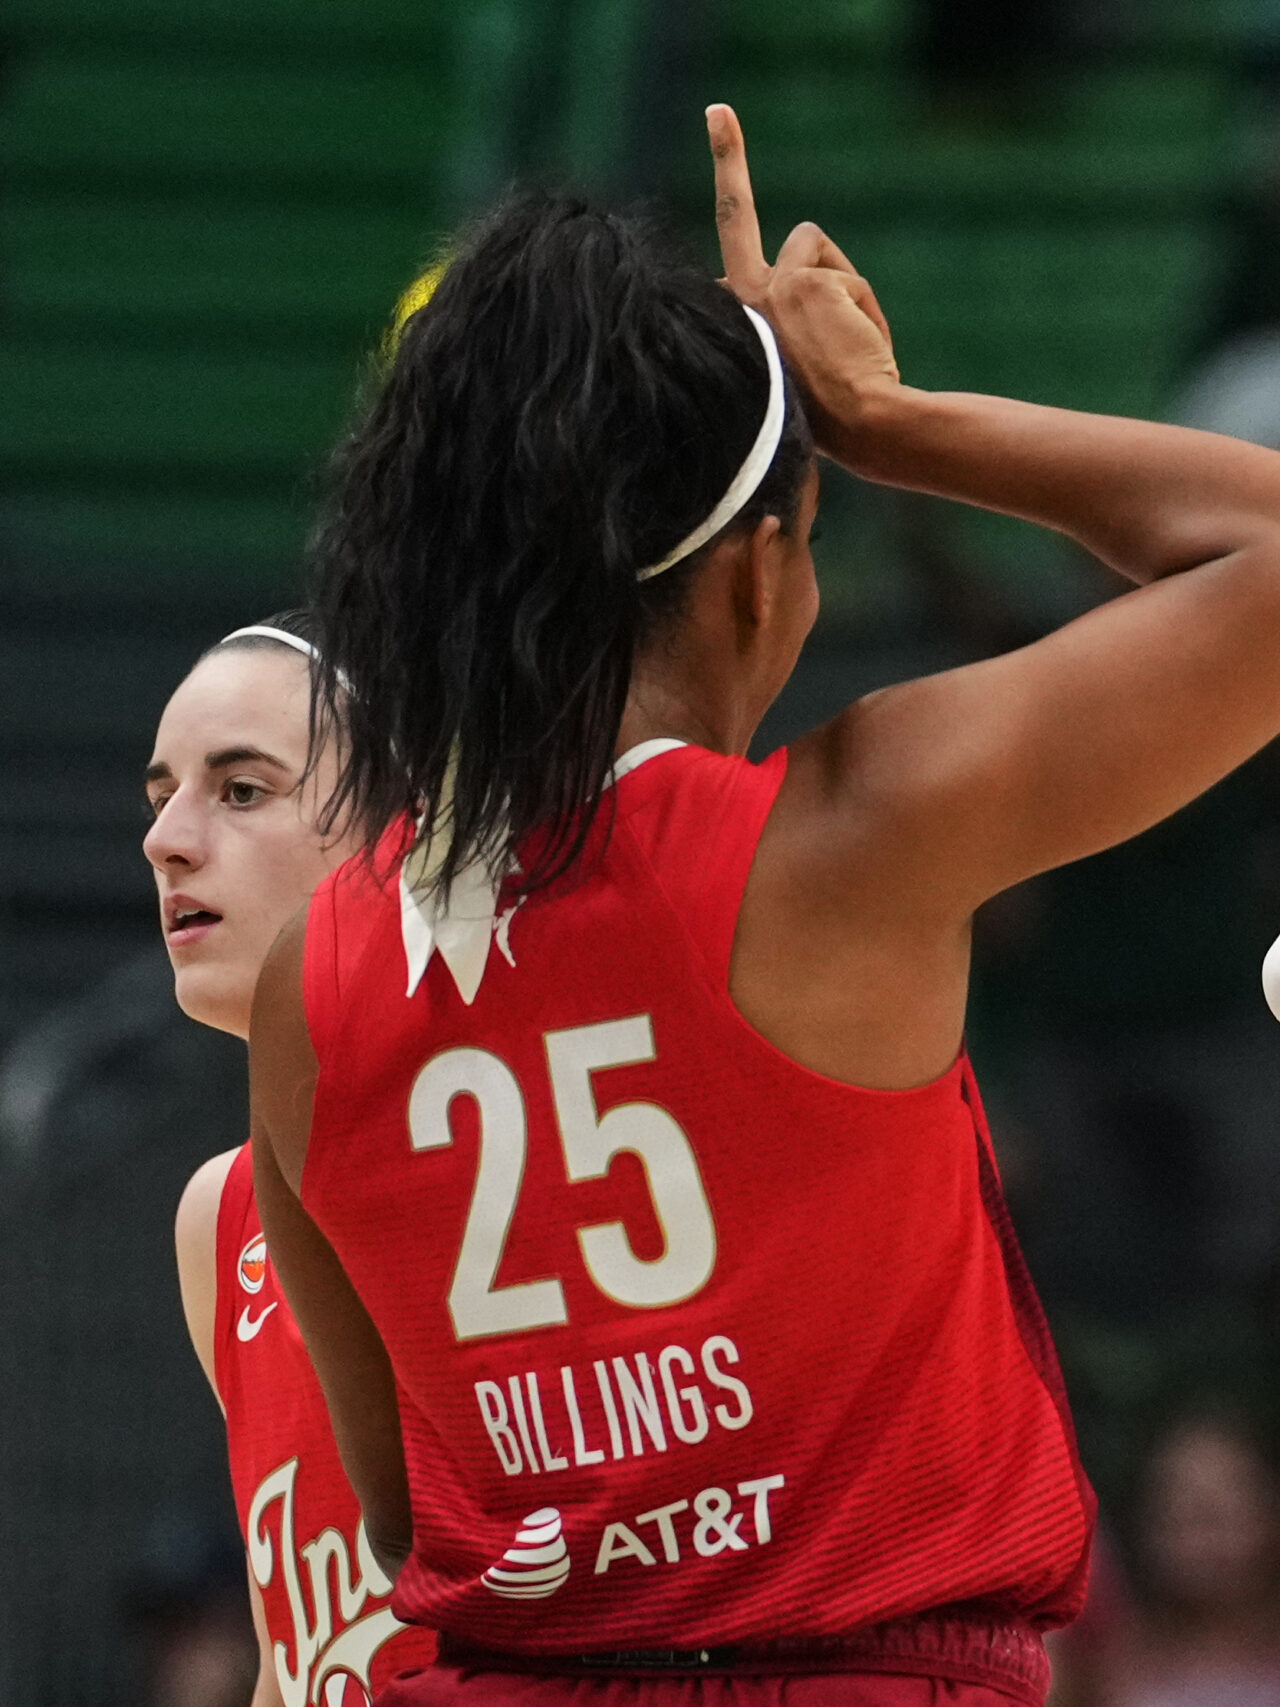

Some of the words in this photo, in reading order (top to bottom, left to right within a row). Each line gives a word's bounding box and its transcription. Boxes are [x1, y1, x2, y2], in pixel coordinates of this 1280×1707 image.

[407, 1012, 717, 1340] 25
[474, 1335, 753, 1476] BILLINGS
[593, 1473, 785, 1575] AT&T
